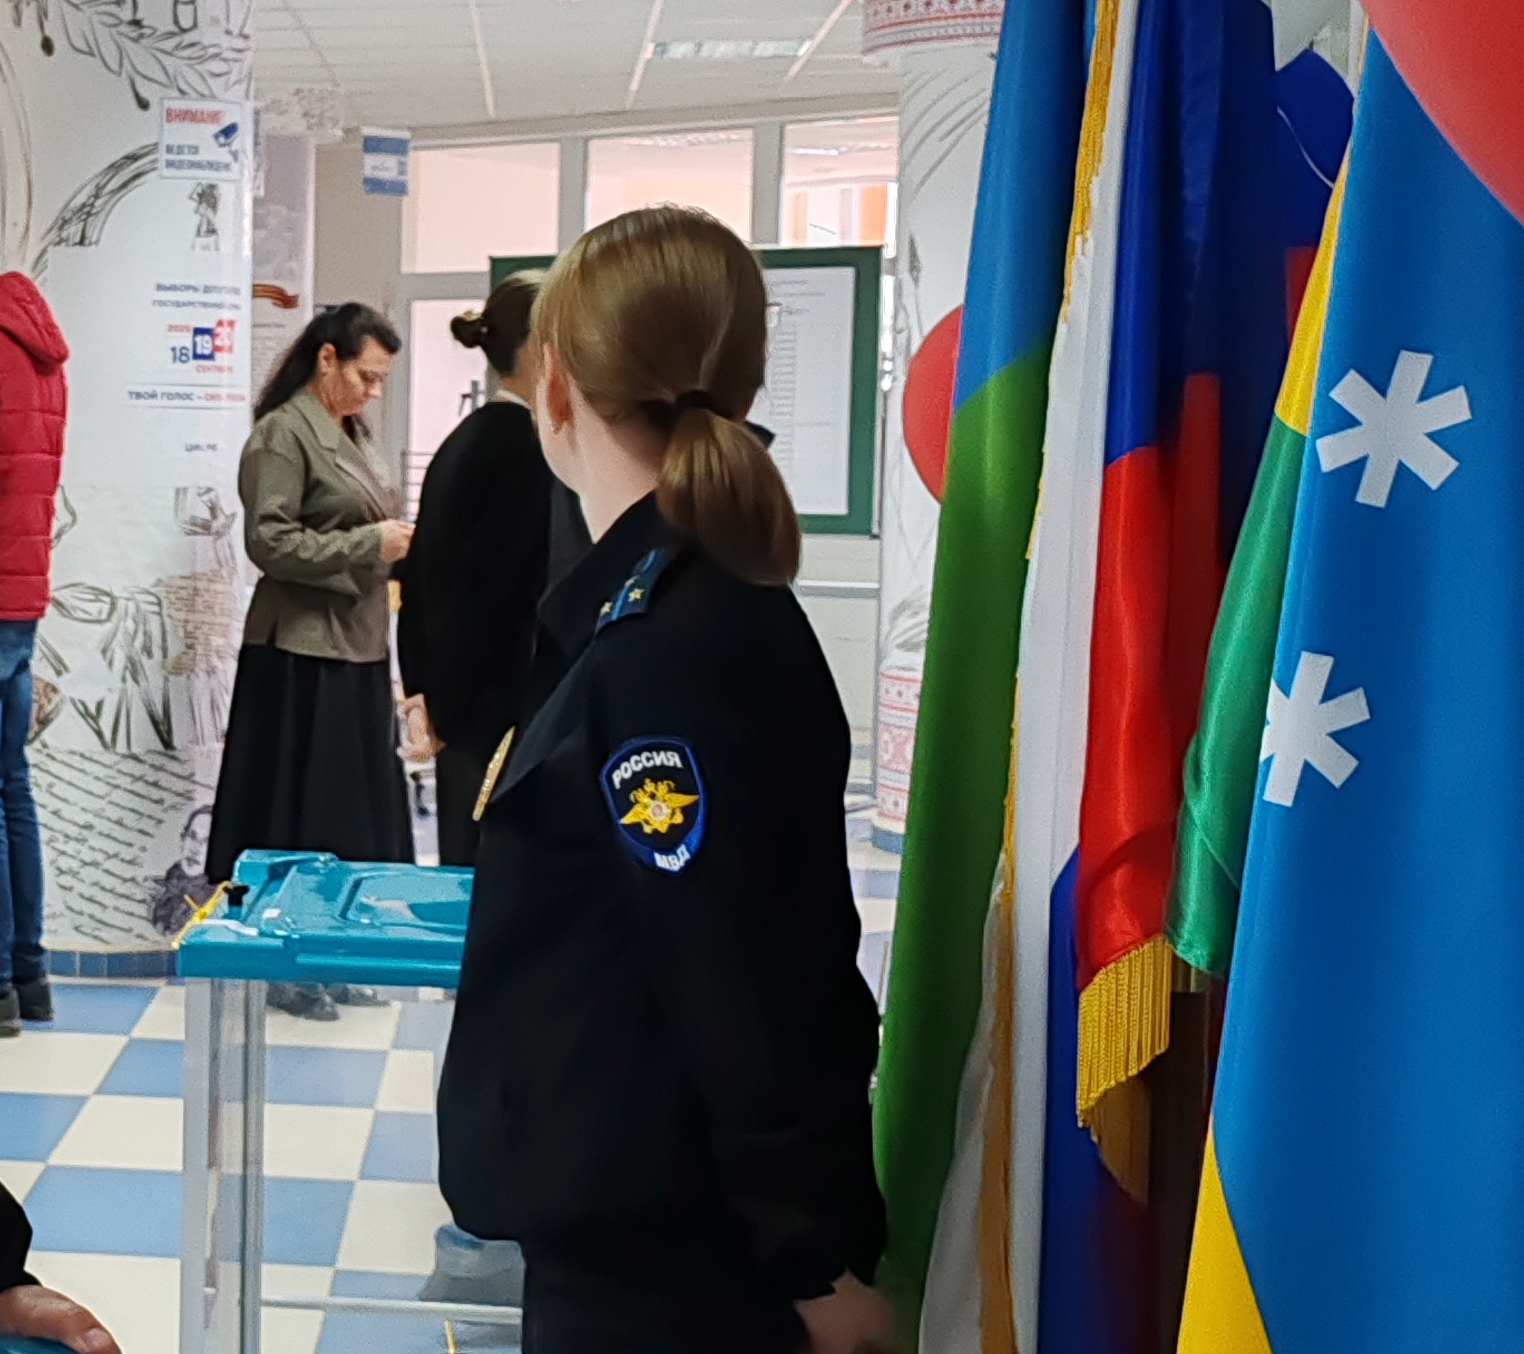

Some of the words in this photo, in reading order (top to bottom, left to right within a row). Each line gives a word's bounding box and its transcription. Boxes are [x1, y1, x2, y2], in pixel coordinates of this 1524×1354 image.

[170, 345, 191, 364] 18
[195, 333, 213, 356] 19
[128, 389, 158, 401] ТВОЙ
[160, 391, 195, 401] ГОЛОС
[612, 750, 684, 790] РОССИЯ
[653, 844, 691, 871] МВД
